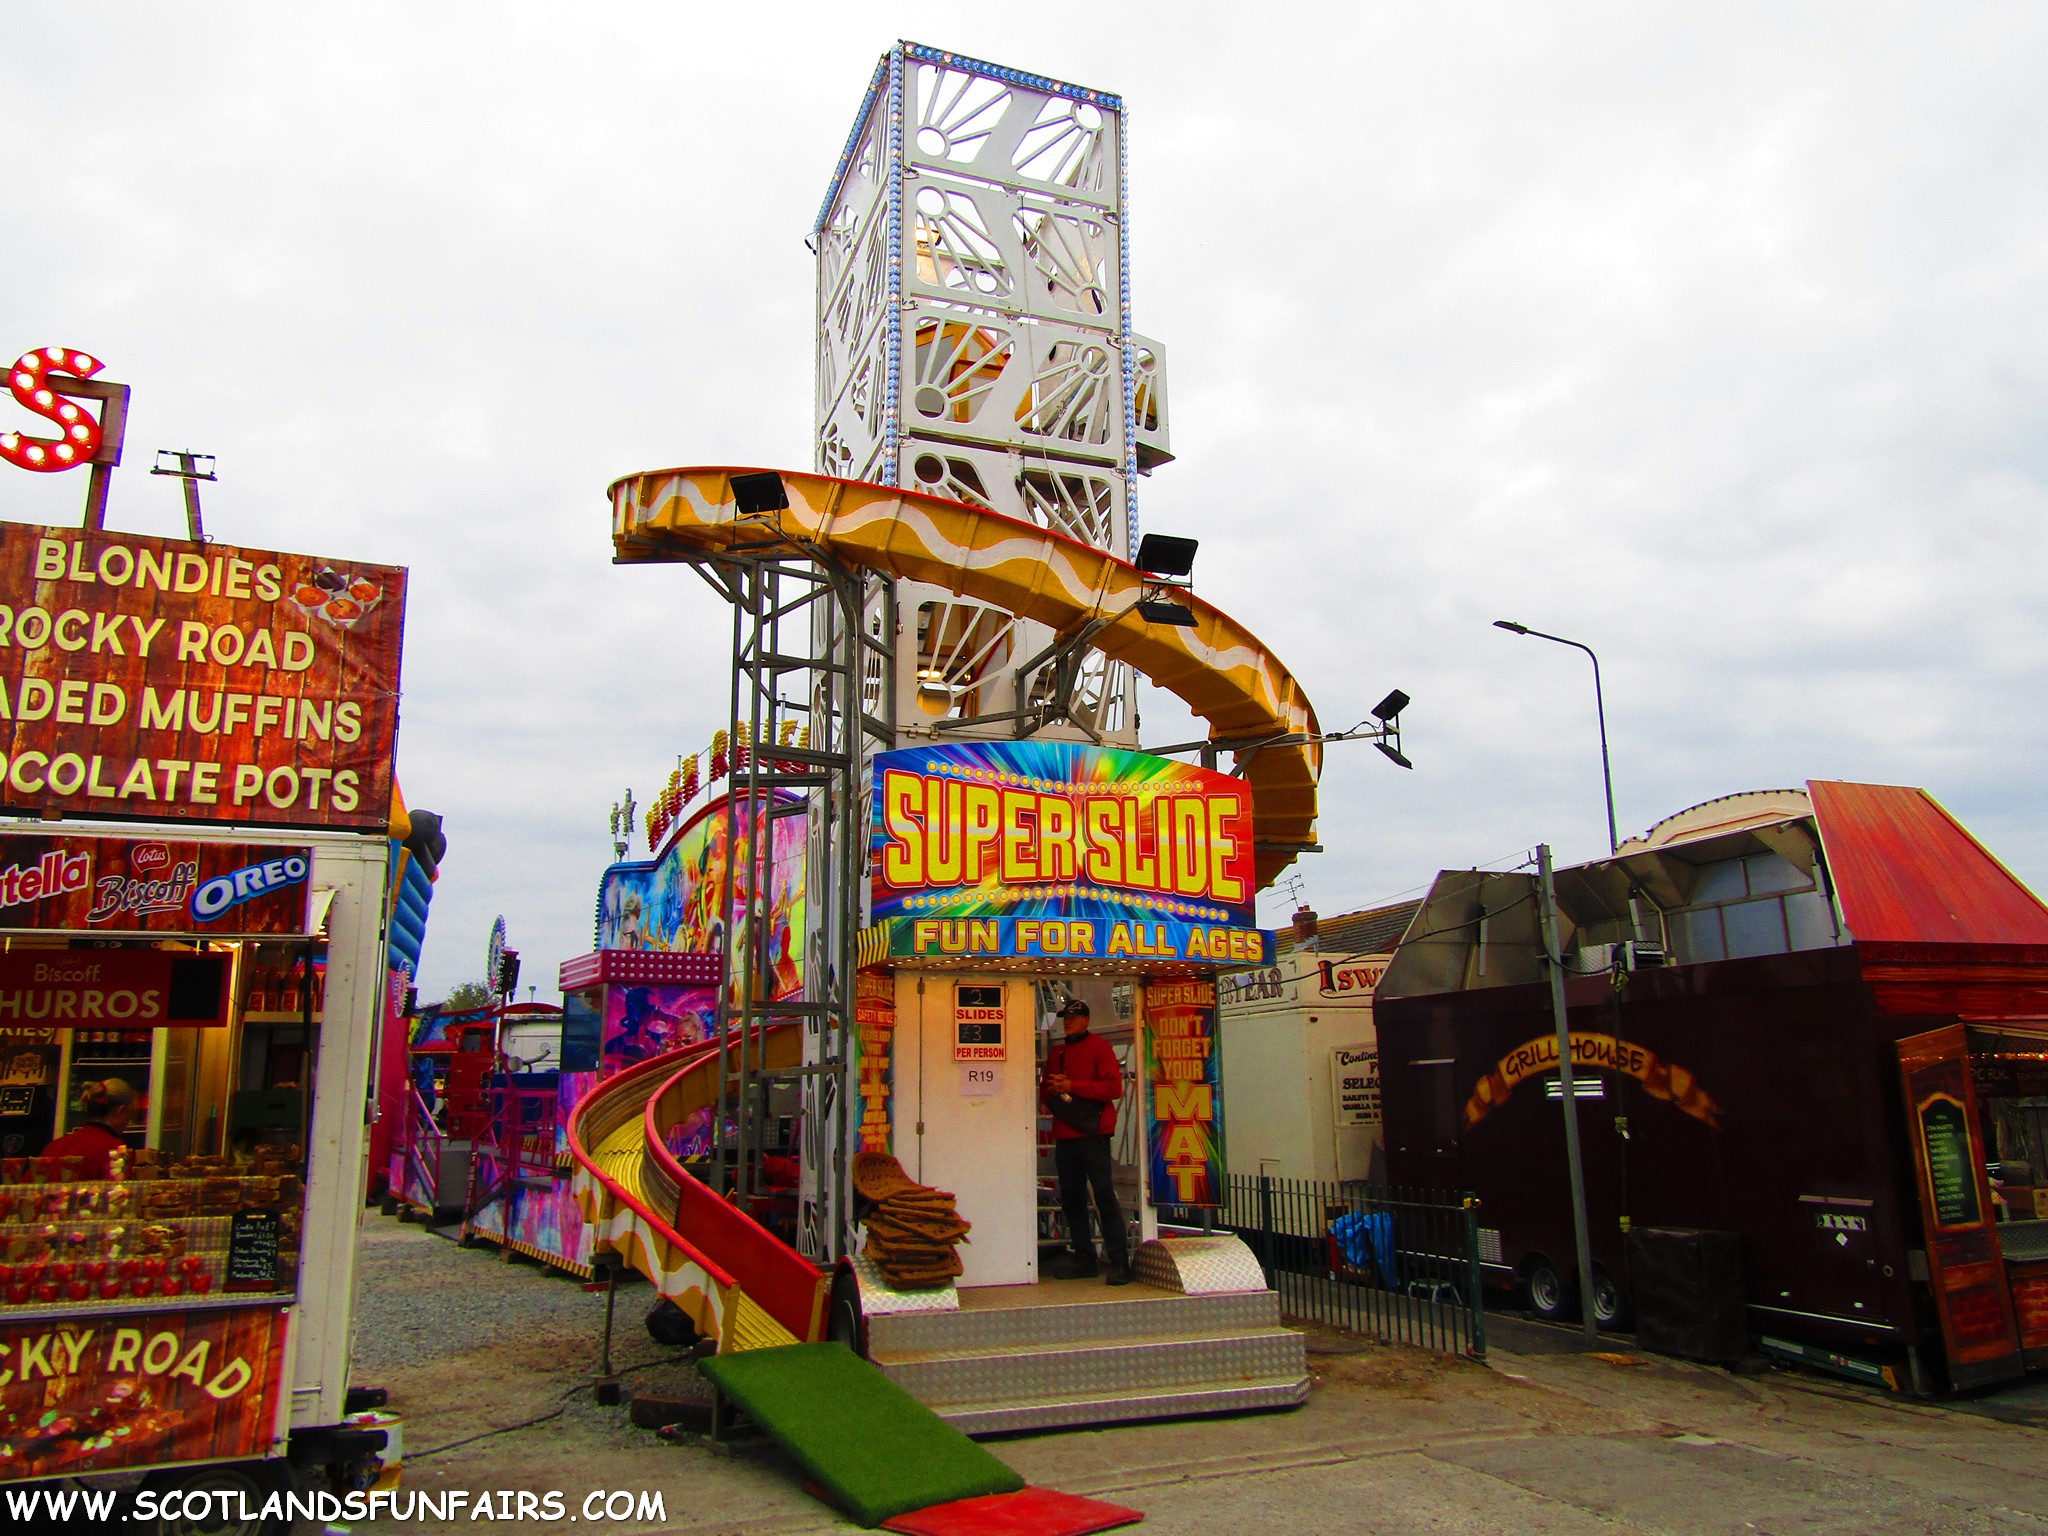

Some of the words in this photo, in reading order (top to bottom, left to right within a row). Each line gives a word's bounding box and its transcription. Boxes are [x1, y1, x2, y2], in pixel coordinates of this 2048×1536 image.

[0, 347, 105, 471] S
[34, 538, 282, 601] BLONDIES
[178, 628, 315, 672] ROAD
[140, 686, 362, 744] MUFFINS
[0, 751, 220, 804] COLATE
[234, 764, 360, 812] POTS
[137, 848, 166, 864] Lotus
[884, 769, 1078, 888] SUPER
[1084, 796, 1246, 904] SLIDE
[0, 850, 90, 909] tella
[86, 861, 197, 922] Biscoff
[193, 857, 307, 916] OREO
[914, 920, 1000, 954] FUN
[1015, 920, 1095, 955] FOR
[1107, 922, 1177, 957] ALL
[1186, 928, 1264, 962] AGES
[969, 988, 985, 1005] 2
[1147, 985, 1181, 1006] SUPER
[1183, 983, 1216, 1005] SLIDE
[1337, 967, 1384, 992] SW
[857, 1009, 876, 1022] SAFETY
[877, 1011, 894, 1024] NOTICE
[956, 1009, 1004, 1020] SLIDES
[1159, 1015, 1204, 1036] DON'T
[956, 1047, 972, 1058] PER
[973, 1047, 1004, 1058] PERSON
[1152, 1036, 1212, 1058] FORGET
[1506, 1040, 1560, 1077] GRILL
[1569, 1037, 1644, 1073] HOUSE
[968, 1070, 994, 1082] R19
[1162, 1059, 1204, 1081] YOUR
[107, 1328, 252, 1398] ROAD
